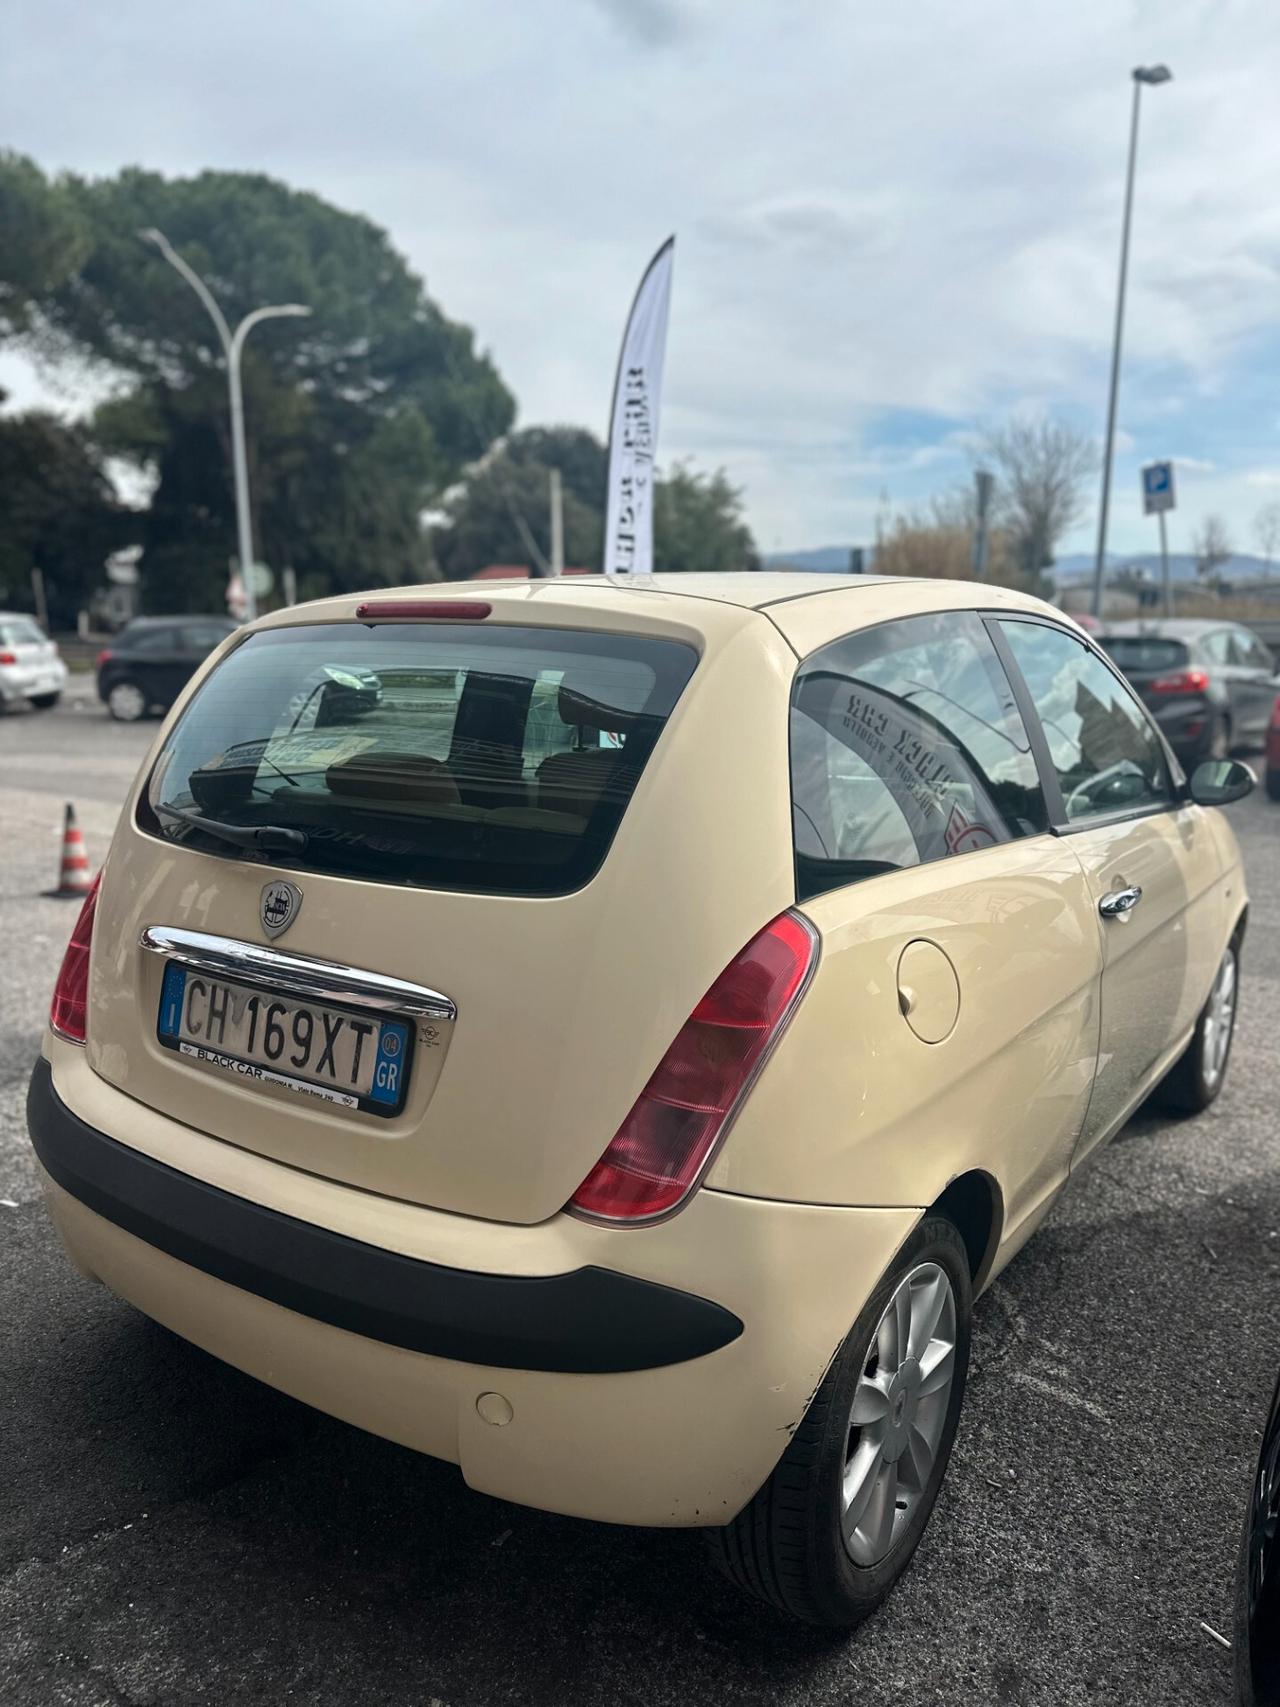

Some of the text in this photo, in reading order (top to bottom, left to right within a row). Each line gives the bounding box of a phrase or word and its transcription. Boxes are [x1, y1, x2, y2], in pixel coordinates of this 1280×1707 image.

[185, 979, 373, 1084] CH 169XT
[197, 1048, 236, 1071] BLACK
[237, 1063, 263, 1080] CAR
[376, 1061, 398, 1091] GR
